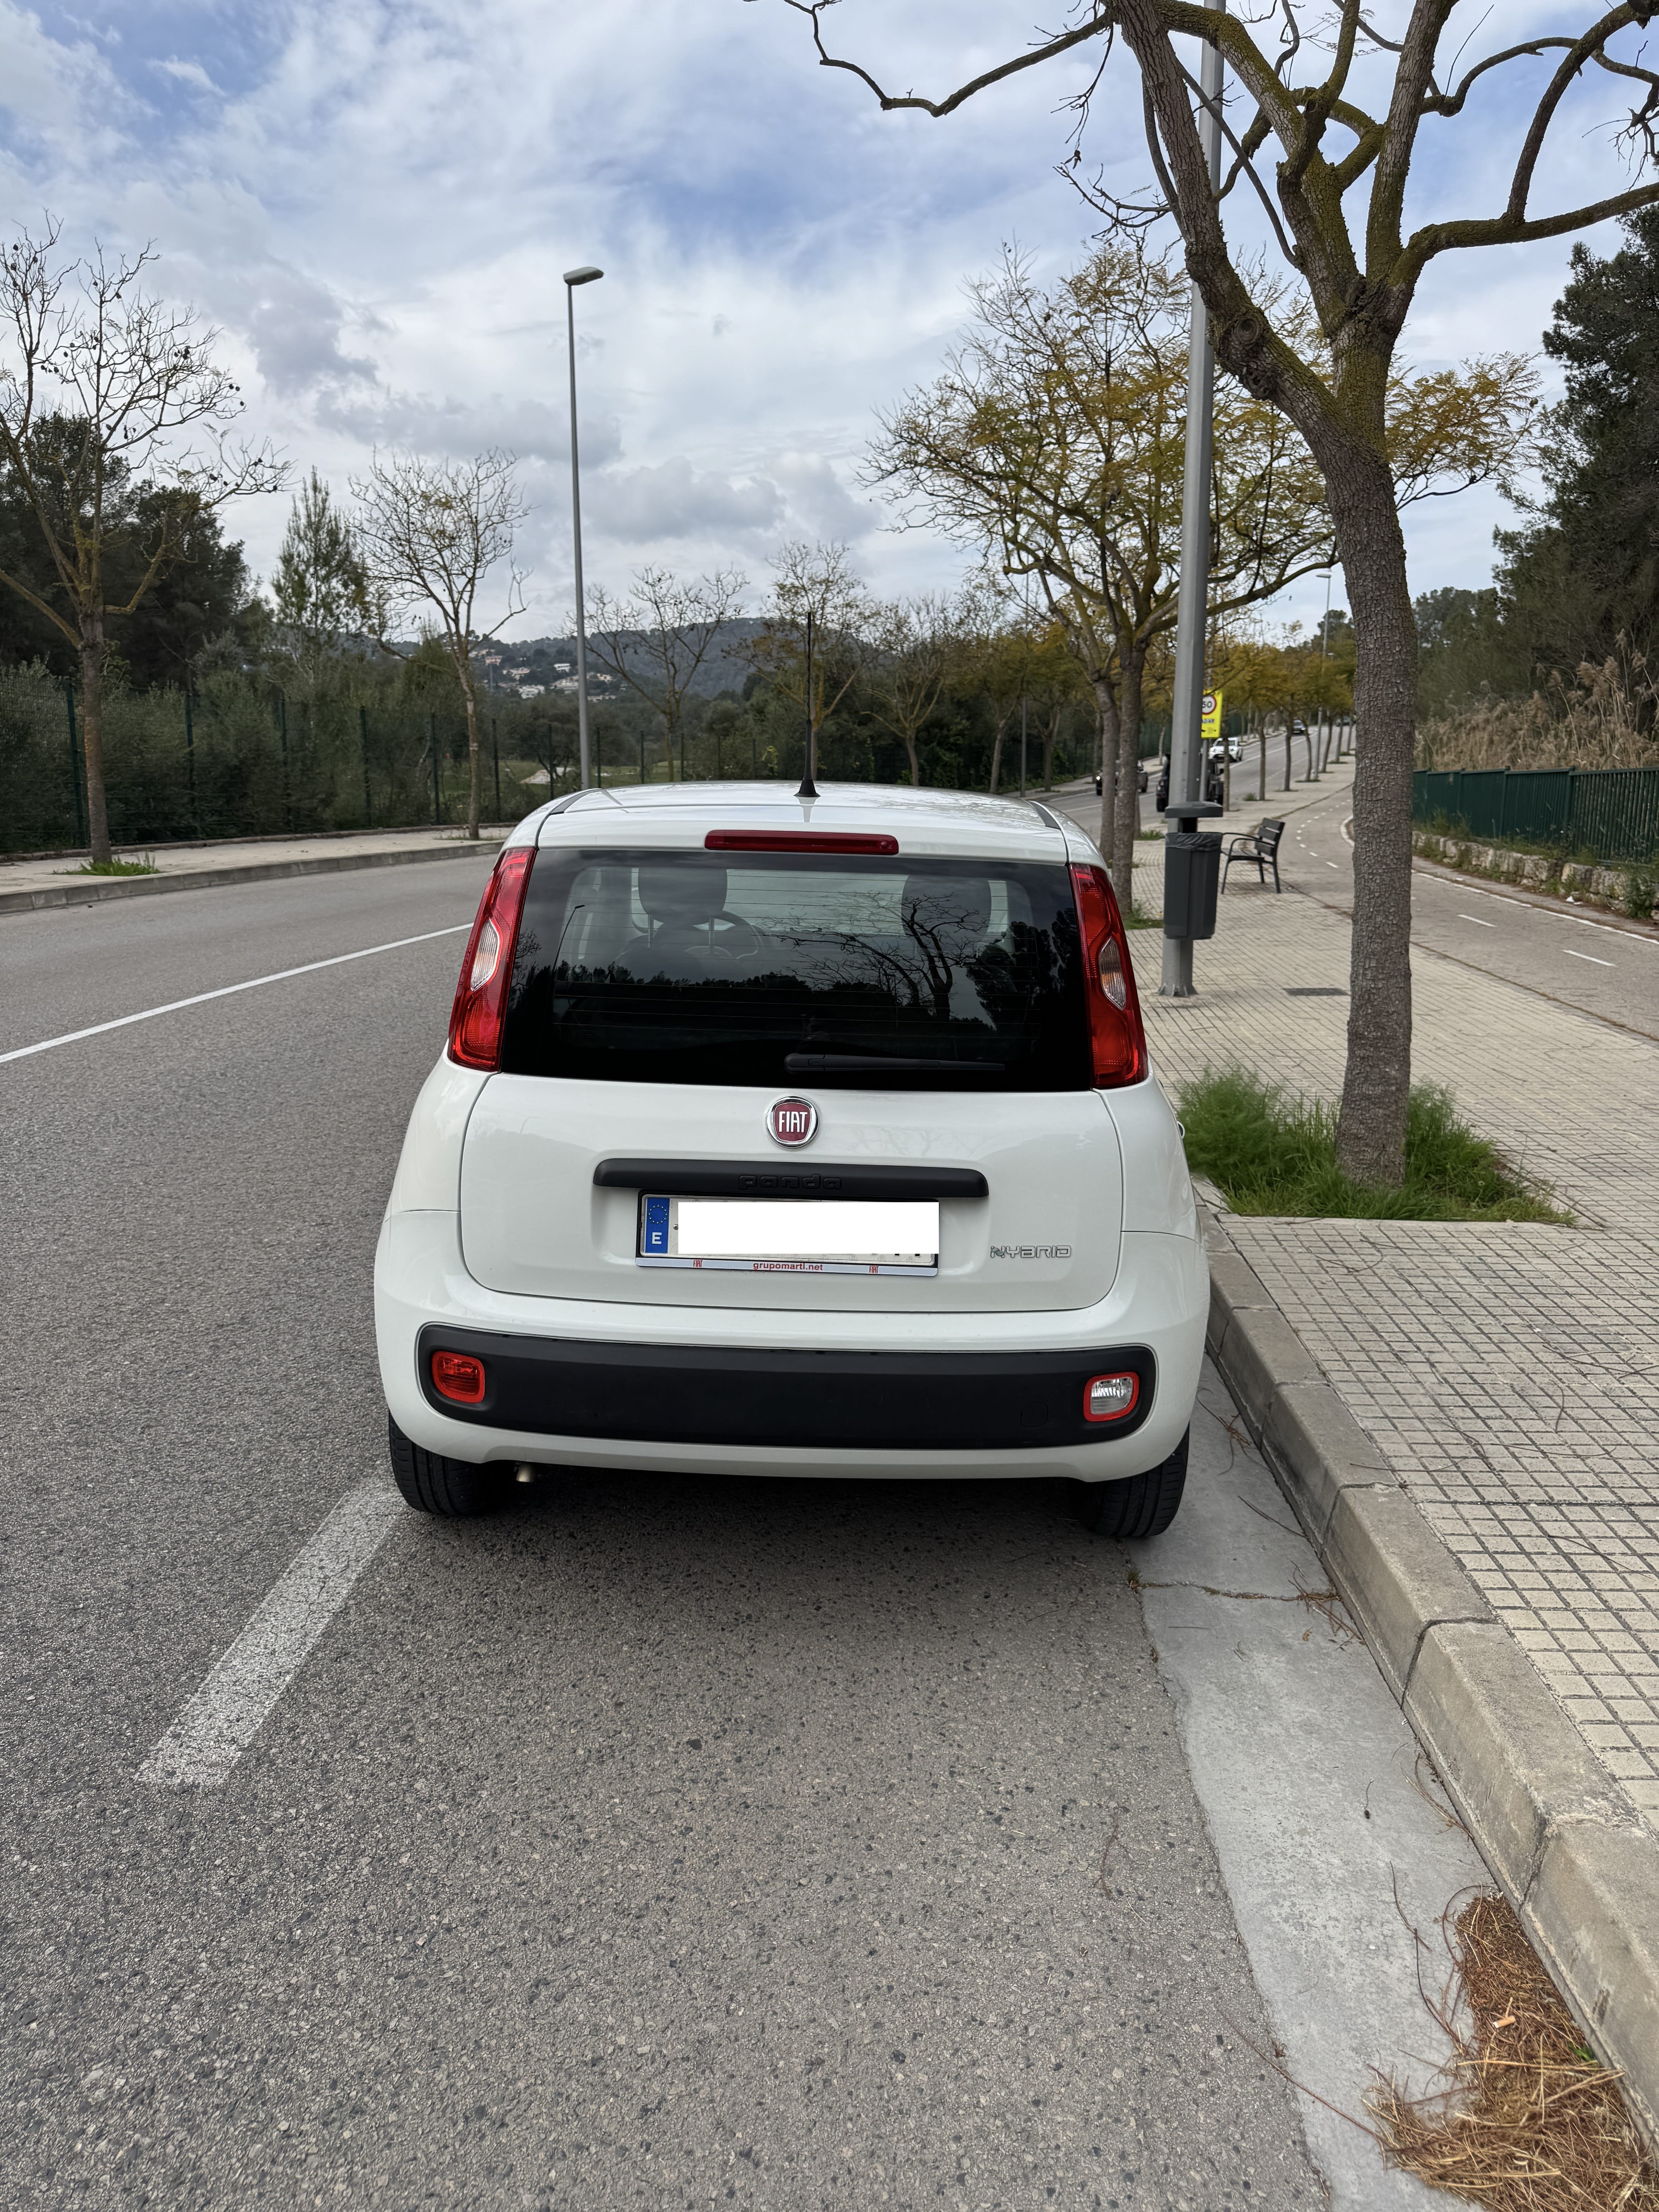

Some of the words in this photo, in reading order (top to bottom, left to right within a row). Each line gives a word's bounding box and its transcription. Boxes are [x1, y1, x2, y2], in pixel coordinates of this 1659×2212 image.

[779, 1111, 808, 1133] FIAT
[738, 1173, 842, 1190] panda
[652, 1232, 662, 1244] E
